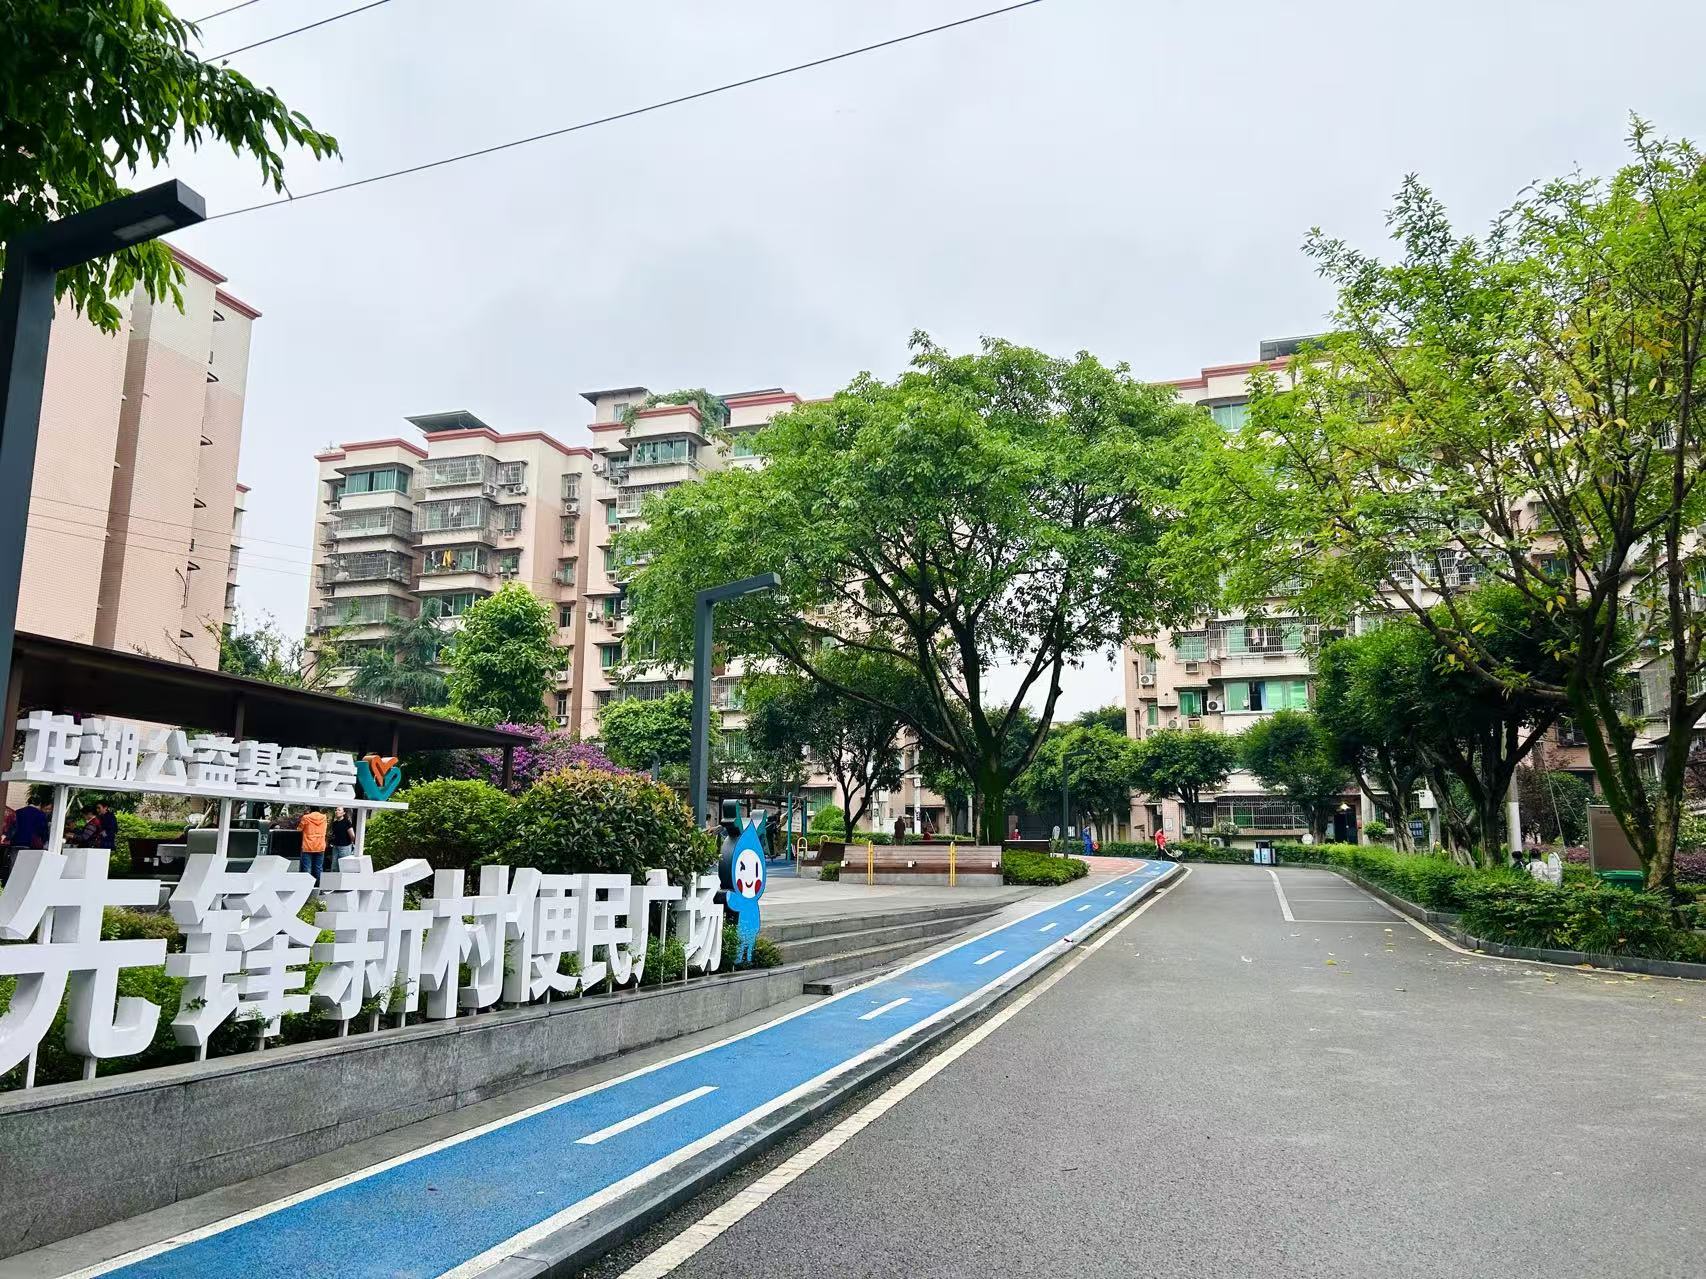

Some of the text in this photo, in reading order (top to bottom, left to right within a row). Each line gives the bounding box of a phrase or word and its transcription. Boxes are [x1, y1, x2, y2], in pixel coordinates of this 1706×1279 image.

[16, 710, 358, 800] 龙湖公益基金会
[0, 848, 724, 1076] 先锋新村便民广场
